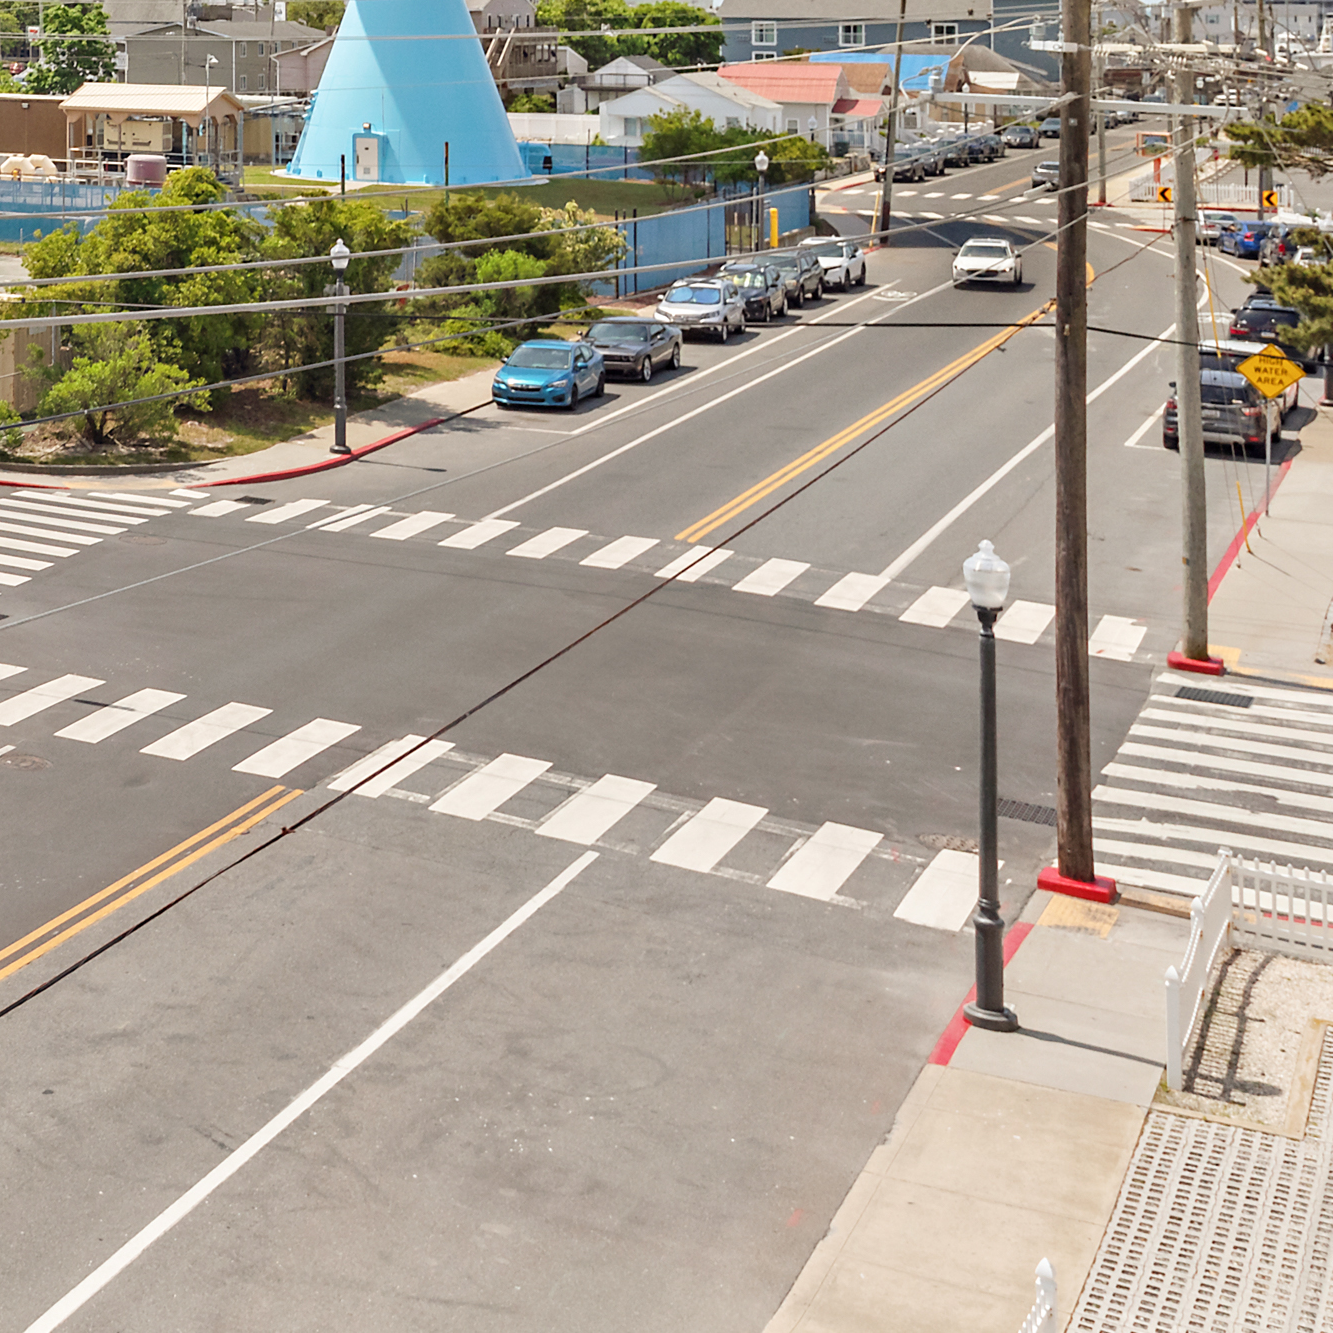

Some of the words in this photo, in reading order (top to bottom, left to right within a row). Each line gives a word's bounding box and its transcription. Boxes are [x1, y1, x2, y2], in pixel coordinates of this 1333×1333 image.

[1259, 356, 1283, 366] HIGH
[1254, 367, 1288, 376] WATER
[1256, 376, 1284, 386] AREA
